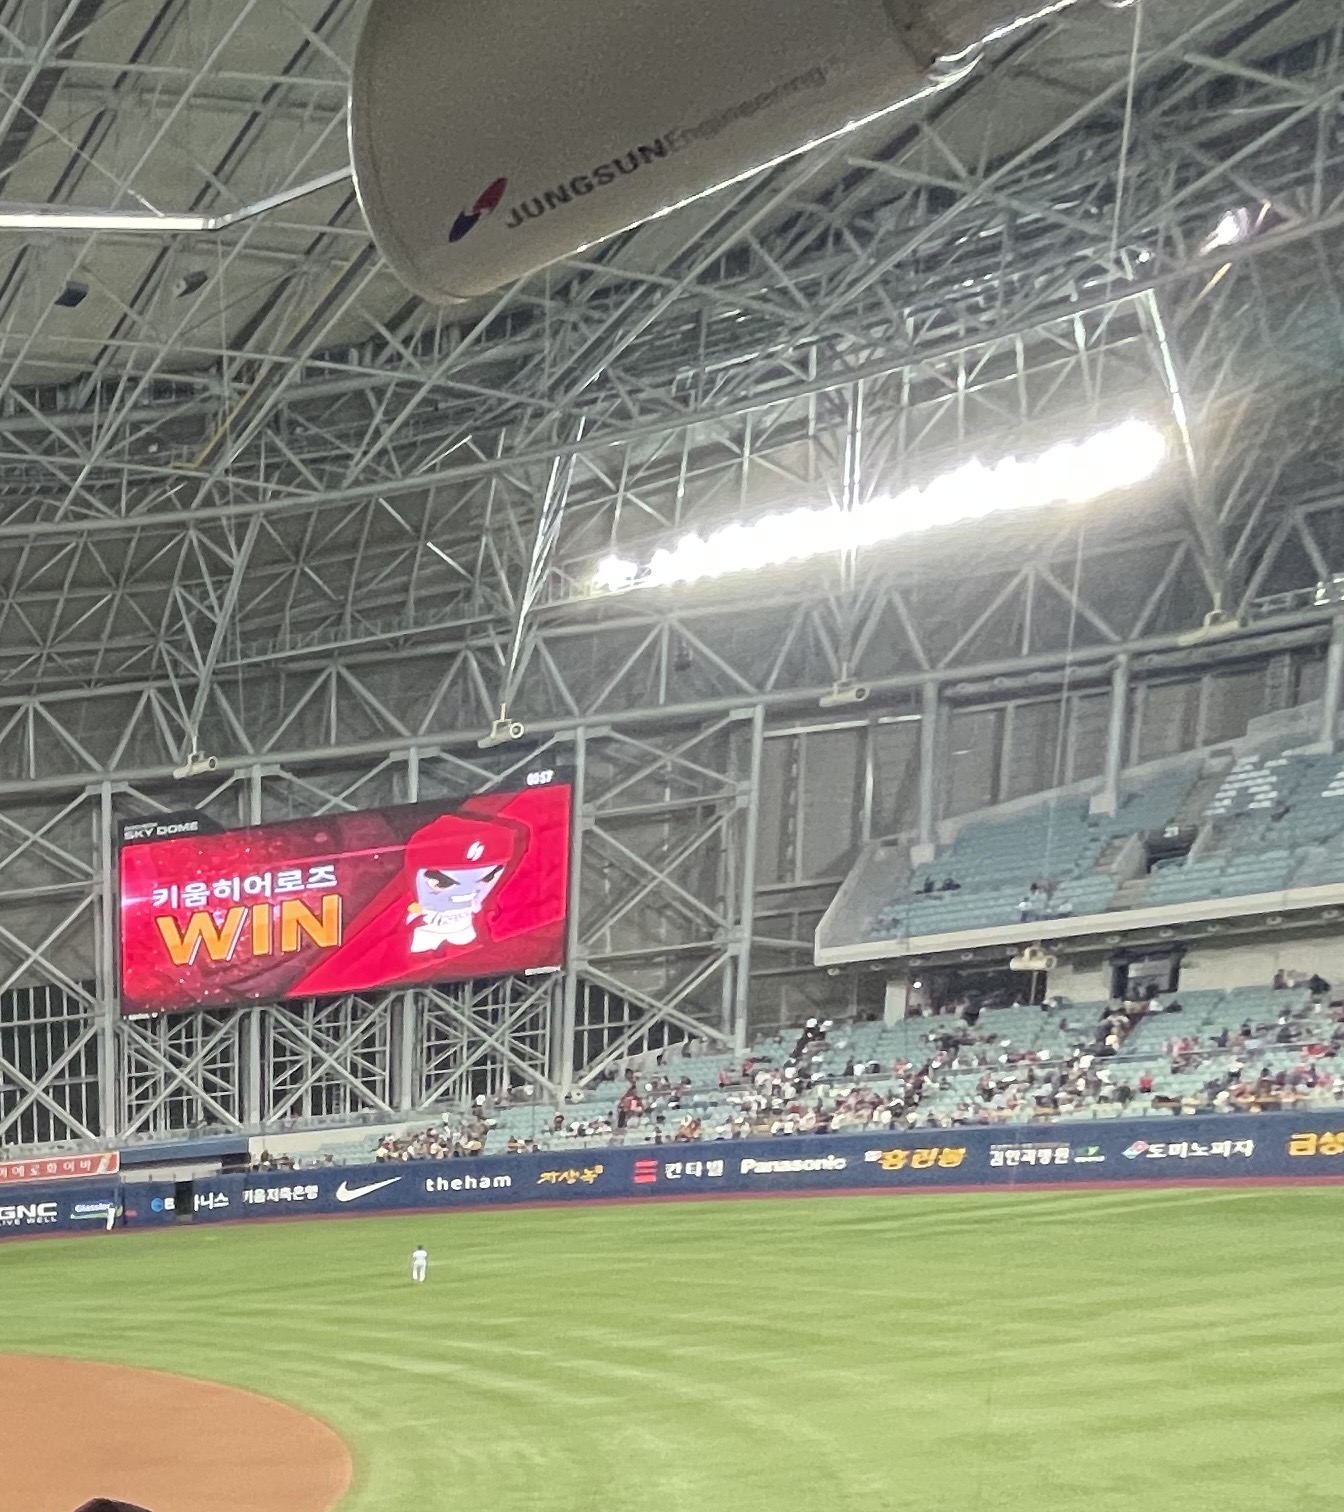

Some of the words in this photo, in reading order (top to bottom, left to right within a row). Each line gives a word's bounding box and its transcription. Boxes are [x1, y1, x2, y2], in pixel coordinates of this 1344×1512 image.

[505, 138, 669, 229] JUNGSUN
[124, 826, 155, 841] SKY
[156, 821, 199, 836] DOME
[153, 865, 338, 909] 키움히어로즈
[156, 894, 343, 966] WIN
[1146, 1138, 1254, 1158] 도미노피자
[740, 1155, 847, 1175] Panasonic
[425, 1175, 512, 1192] theham
[26, 1216, 58, 1225] WELL
